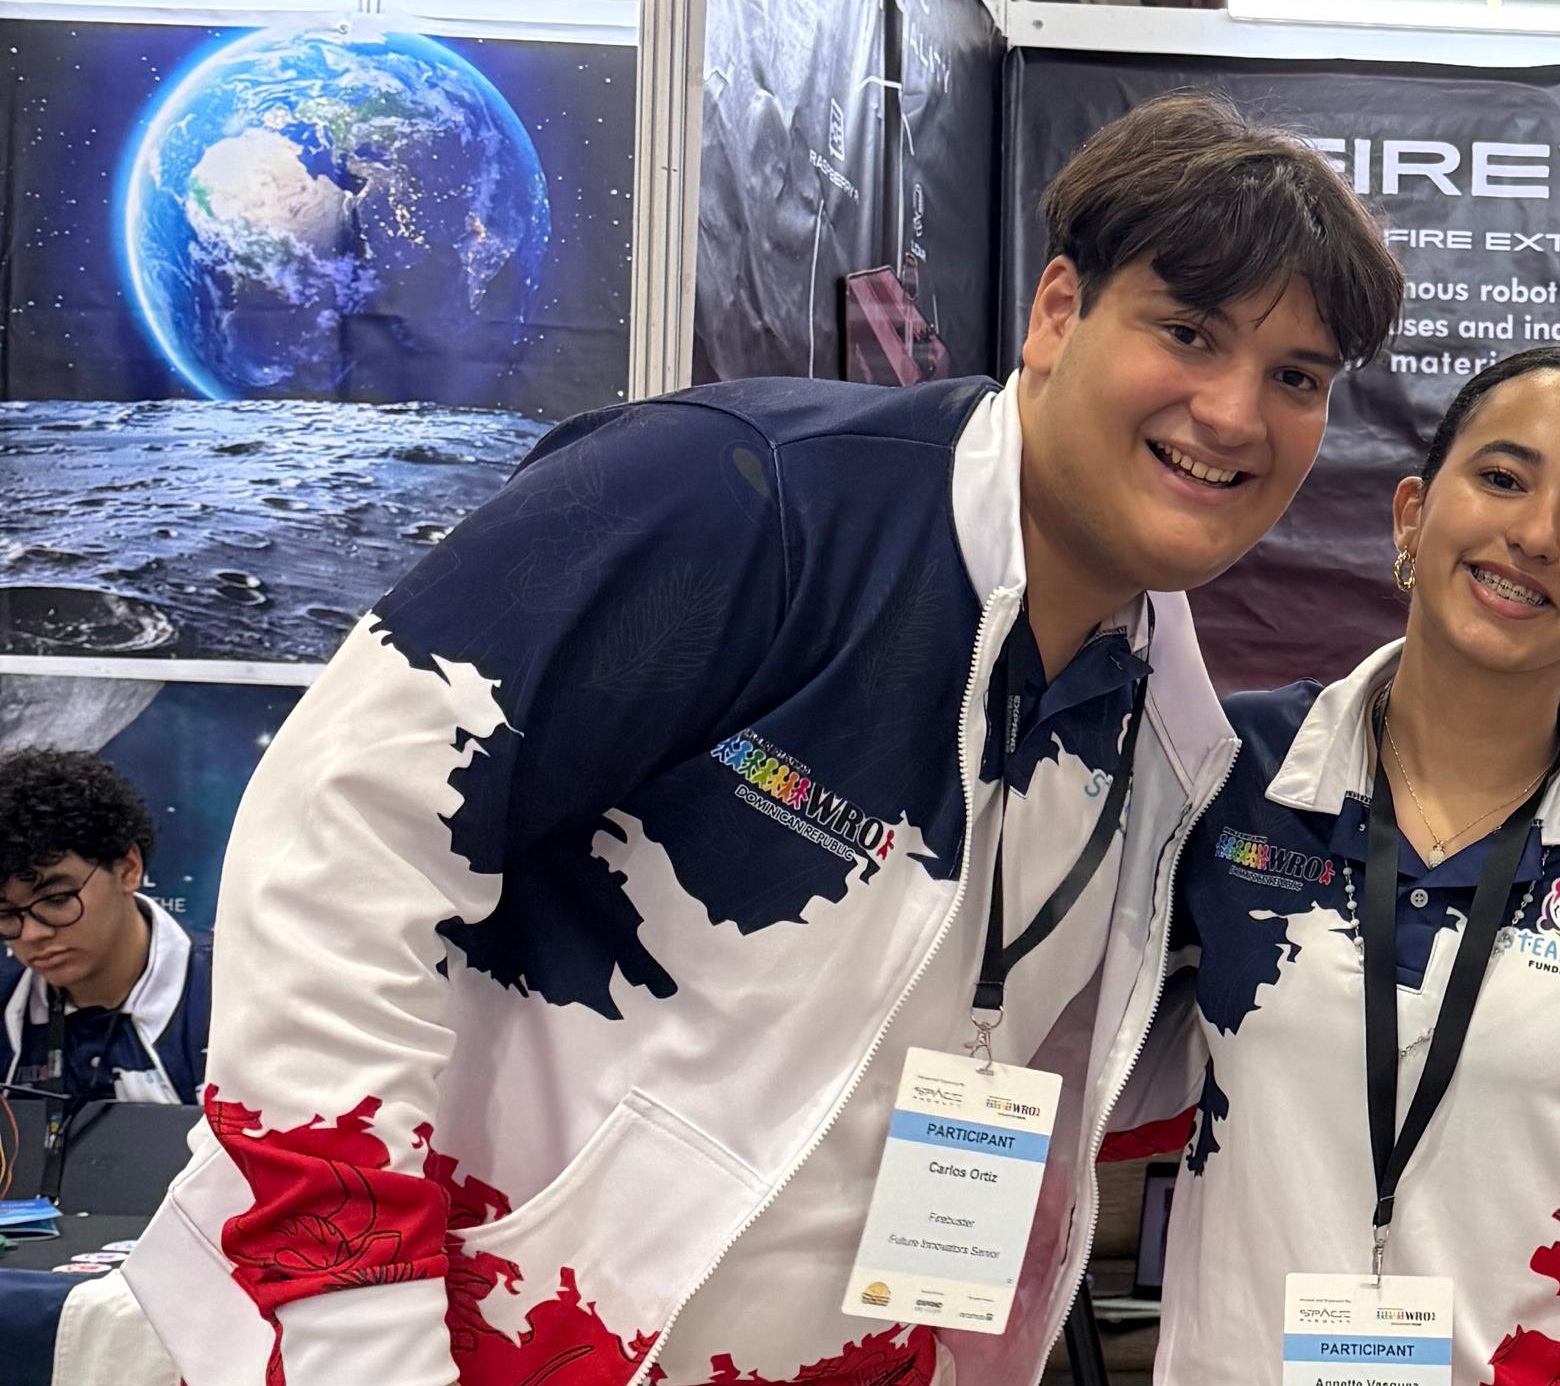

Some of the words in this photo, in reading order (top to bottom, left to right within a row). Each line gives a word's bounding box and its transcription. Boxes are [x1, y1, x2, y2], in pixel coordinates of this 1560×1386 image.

[1384, 229, 1471, 251] FIRE
[1481, 278, 1557, 304] robot
[1459, 313, 1513, 340] and
[735, 784, 805, 834] DOMINICAN
[804, 825, 856, 862] REPUBLIC
[805, 782, 884, 851] WRO
[1269, 845, 1324, 882] WRO
[927, 1123, 1015, 1149] PARTICIPANT
[929, 1161, 966, 1179] Carlos
[970, 1168, 998, 1183] Ortiz
[1320, 1342, 1415, 1357] PARTICIPANT
